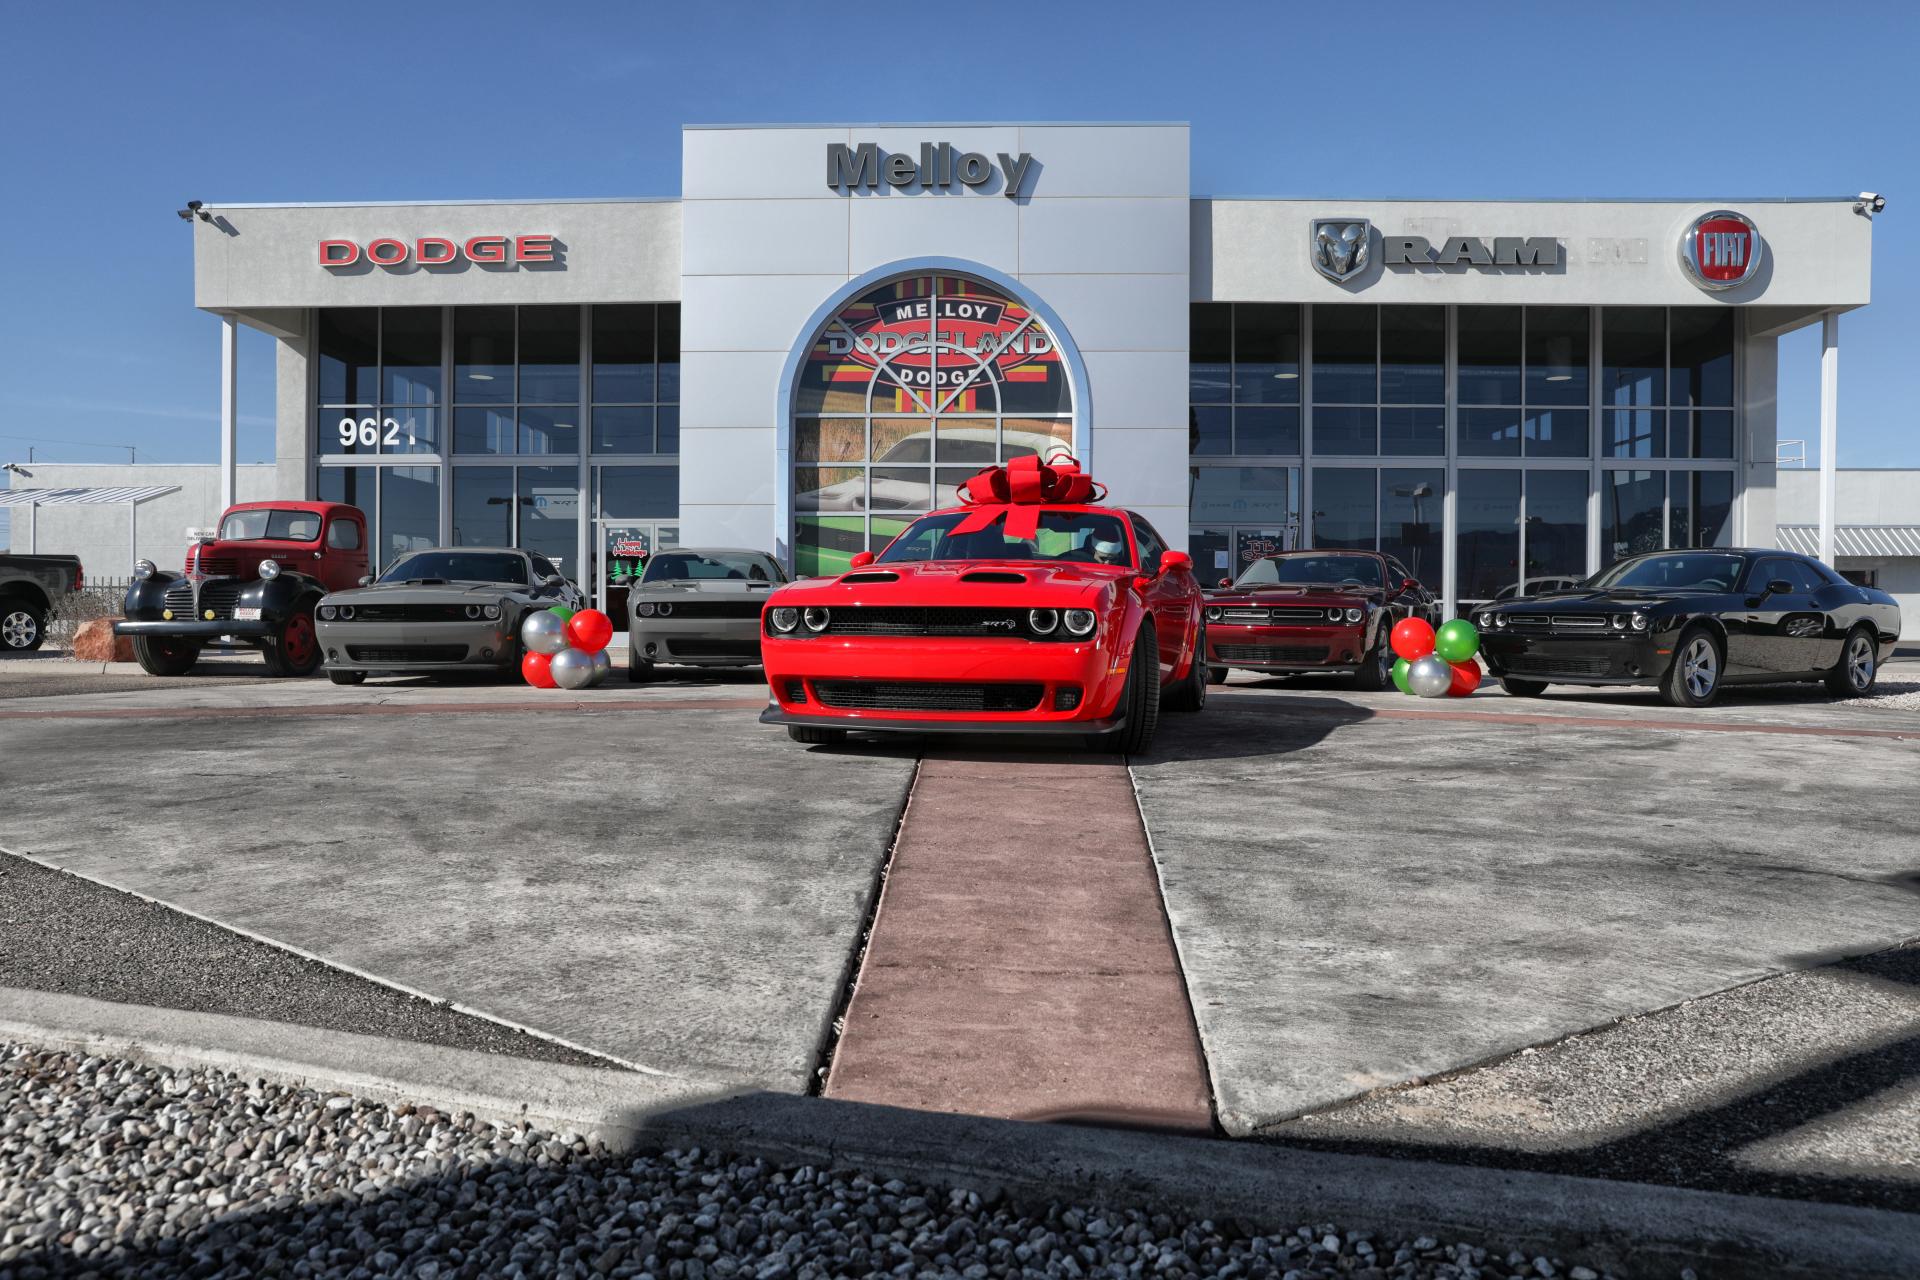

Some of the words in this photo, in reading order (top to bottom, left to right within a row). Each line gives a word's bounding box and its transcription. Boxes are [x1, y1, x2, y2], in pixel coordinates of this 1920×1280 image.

[827, 142, 1031, 196] Melloy
[319, 235, 555, 265] DODGE
[1383, 236, 1557, 265] RAM
[1703, 232, 1747, 267] FIAT
[896, 303, 988, 320] MELOY
[824, 331, 1054, 354] DODGELAND
[339, 417, 416, 446] 9621
